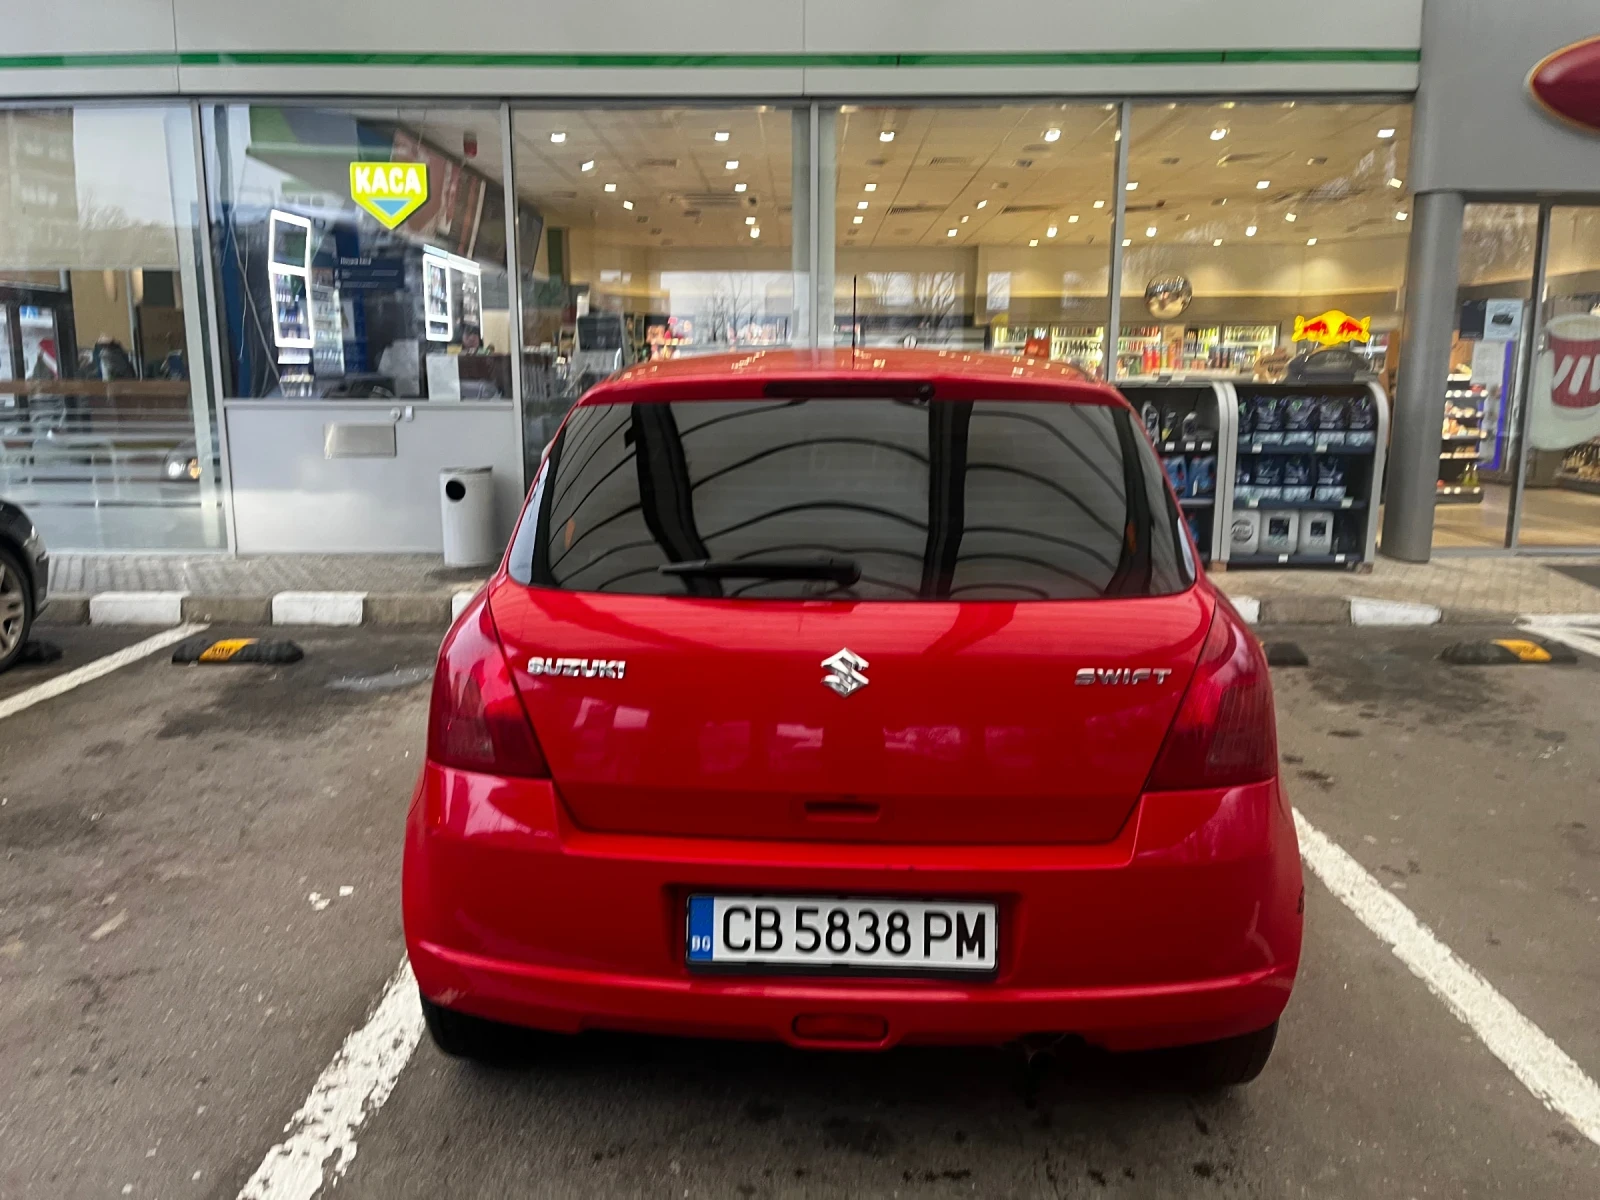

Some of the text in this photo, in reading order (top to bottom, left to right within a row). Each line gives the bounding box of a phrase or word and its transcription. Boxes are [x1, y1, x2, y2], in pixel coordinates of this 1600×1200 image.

[355, 166, 421, 195] КАСА
[527, 656, 626, 679] SUZUKI
[1074, 667, 1172, 685] SWIFT
[722, 905, 986, 961] CB 5838 PM
